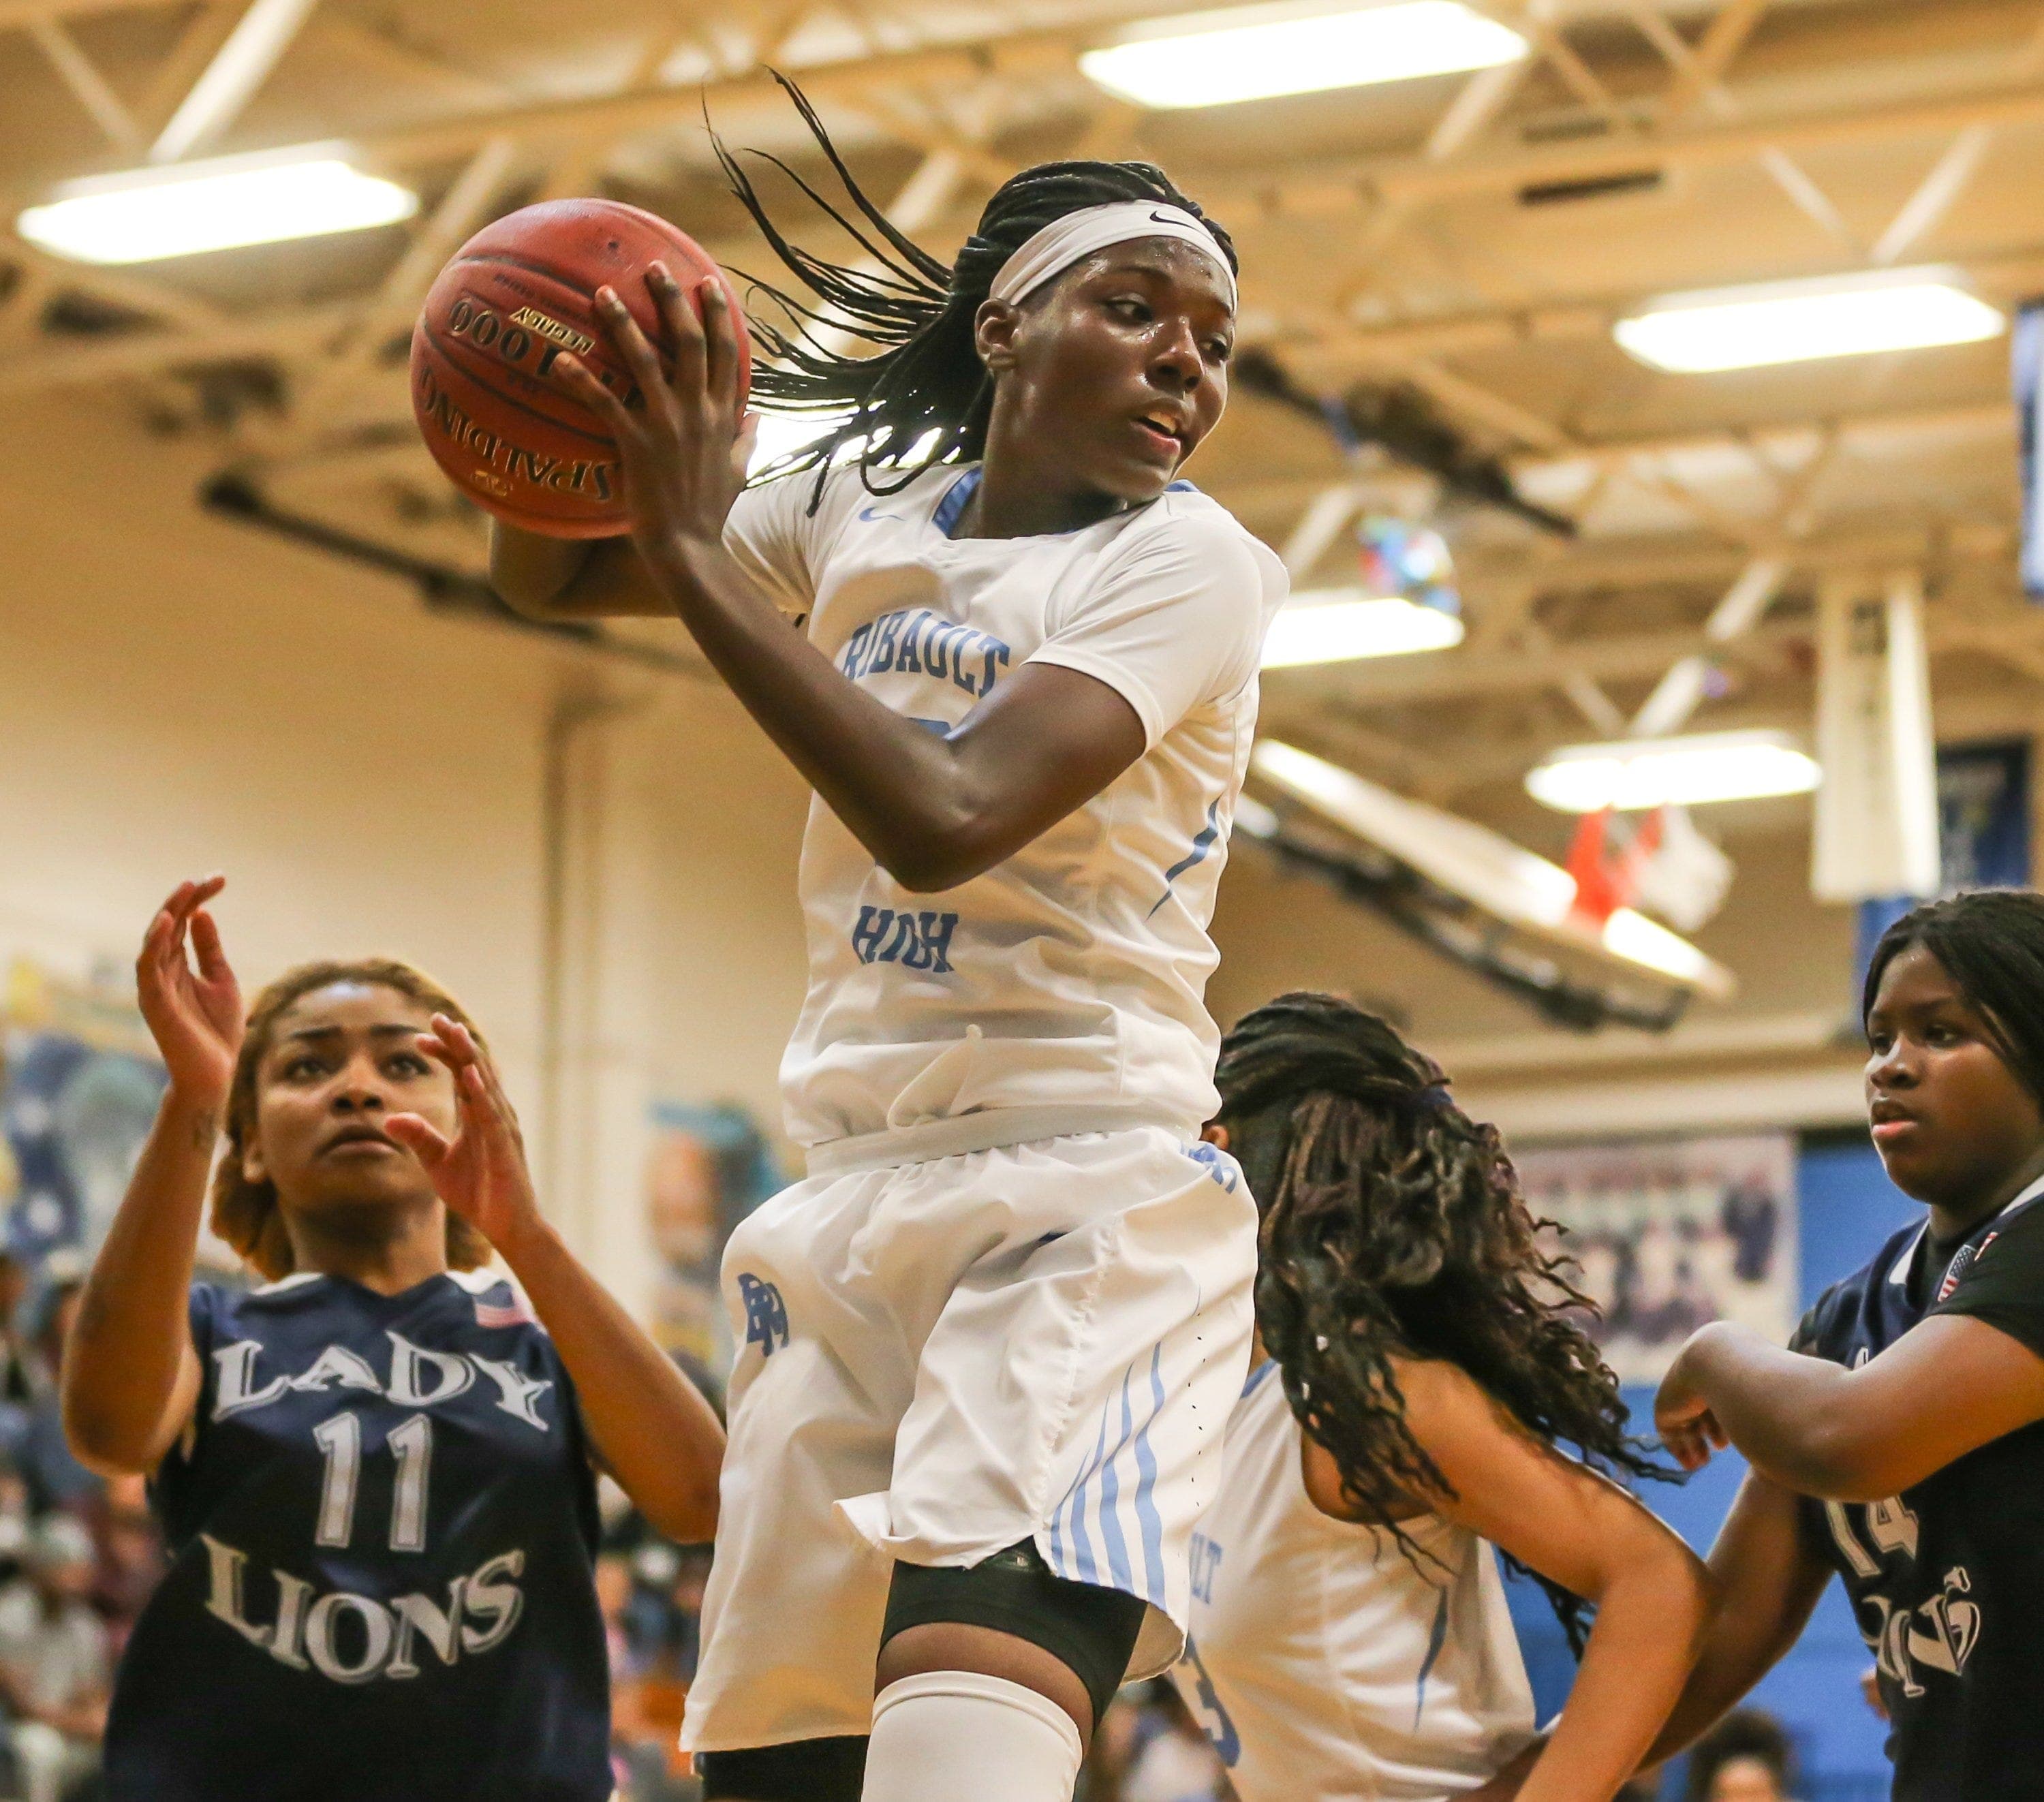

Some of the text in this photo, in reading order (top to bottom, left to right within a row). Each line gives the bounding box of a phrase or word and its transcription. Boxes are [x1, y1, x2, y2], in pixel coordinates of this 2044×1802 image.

[418, 365, 621, 501] SPALDING
[843, 610, 1010, 698] RIBAULT
[211, 1330, 553, 1432] LADY
[313, 1411, 433, 1553] 11
[1824, 1495, 1919, 1579] 14
[199, 1533, 525, 1685] LIONS
